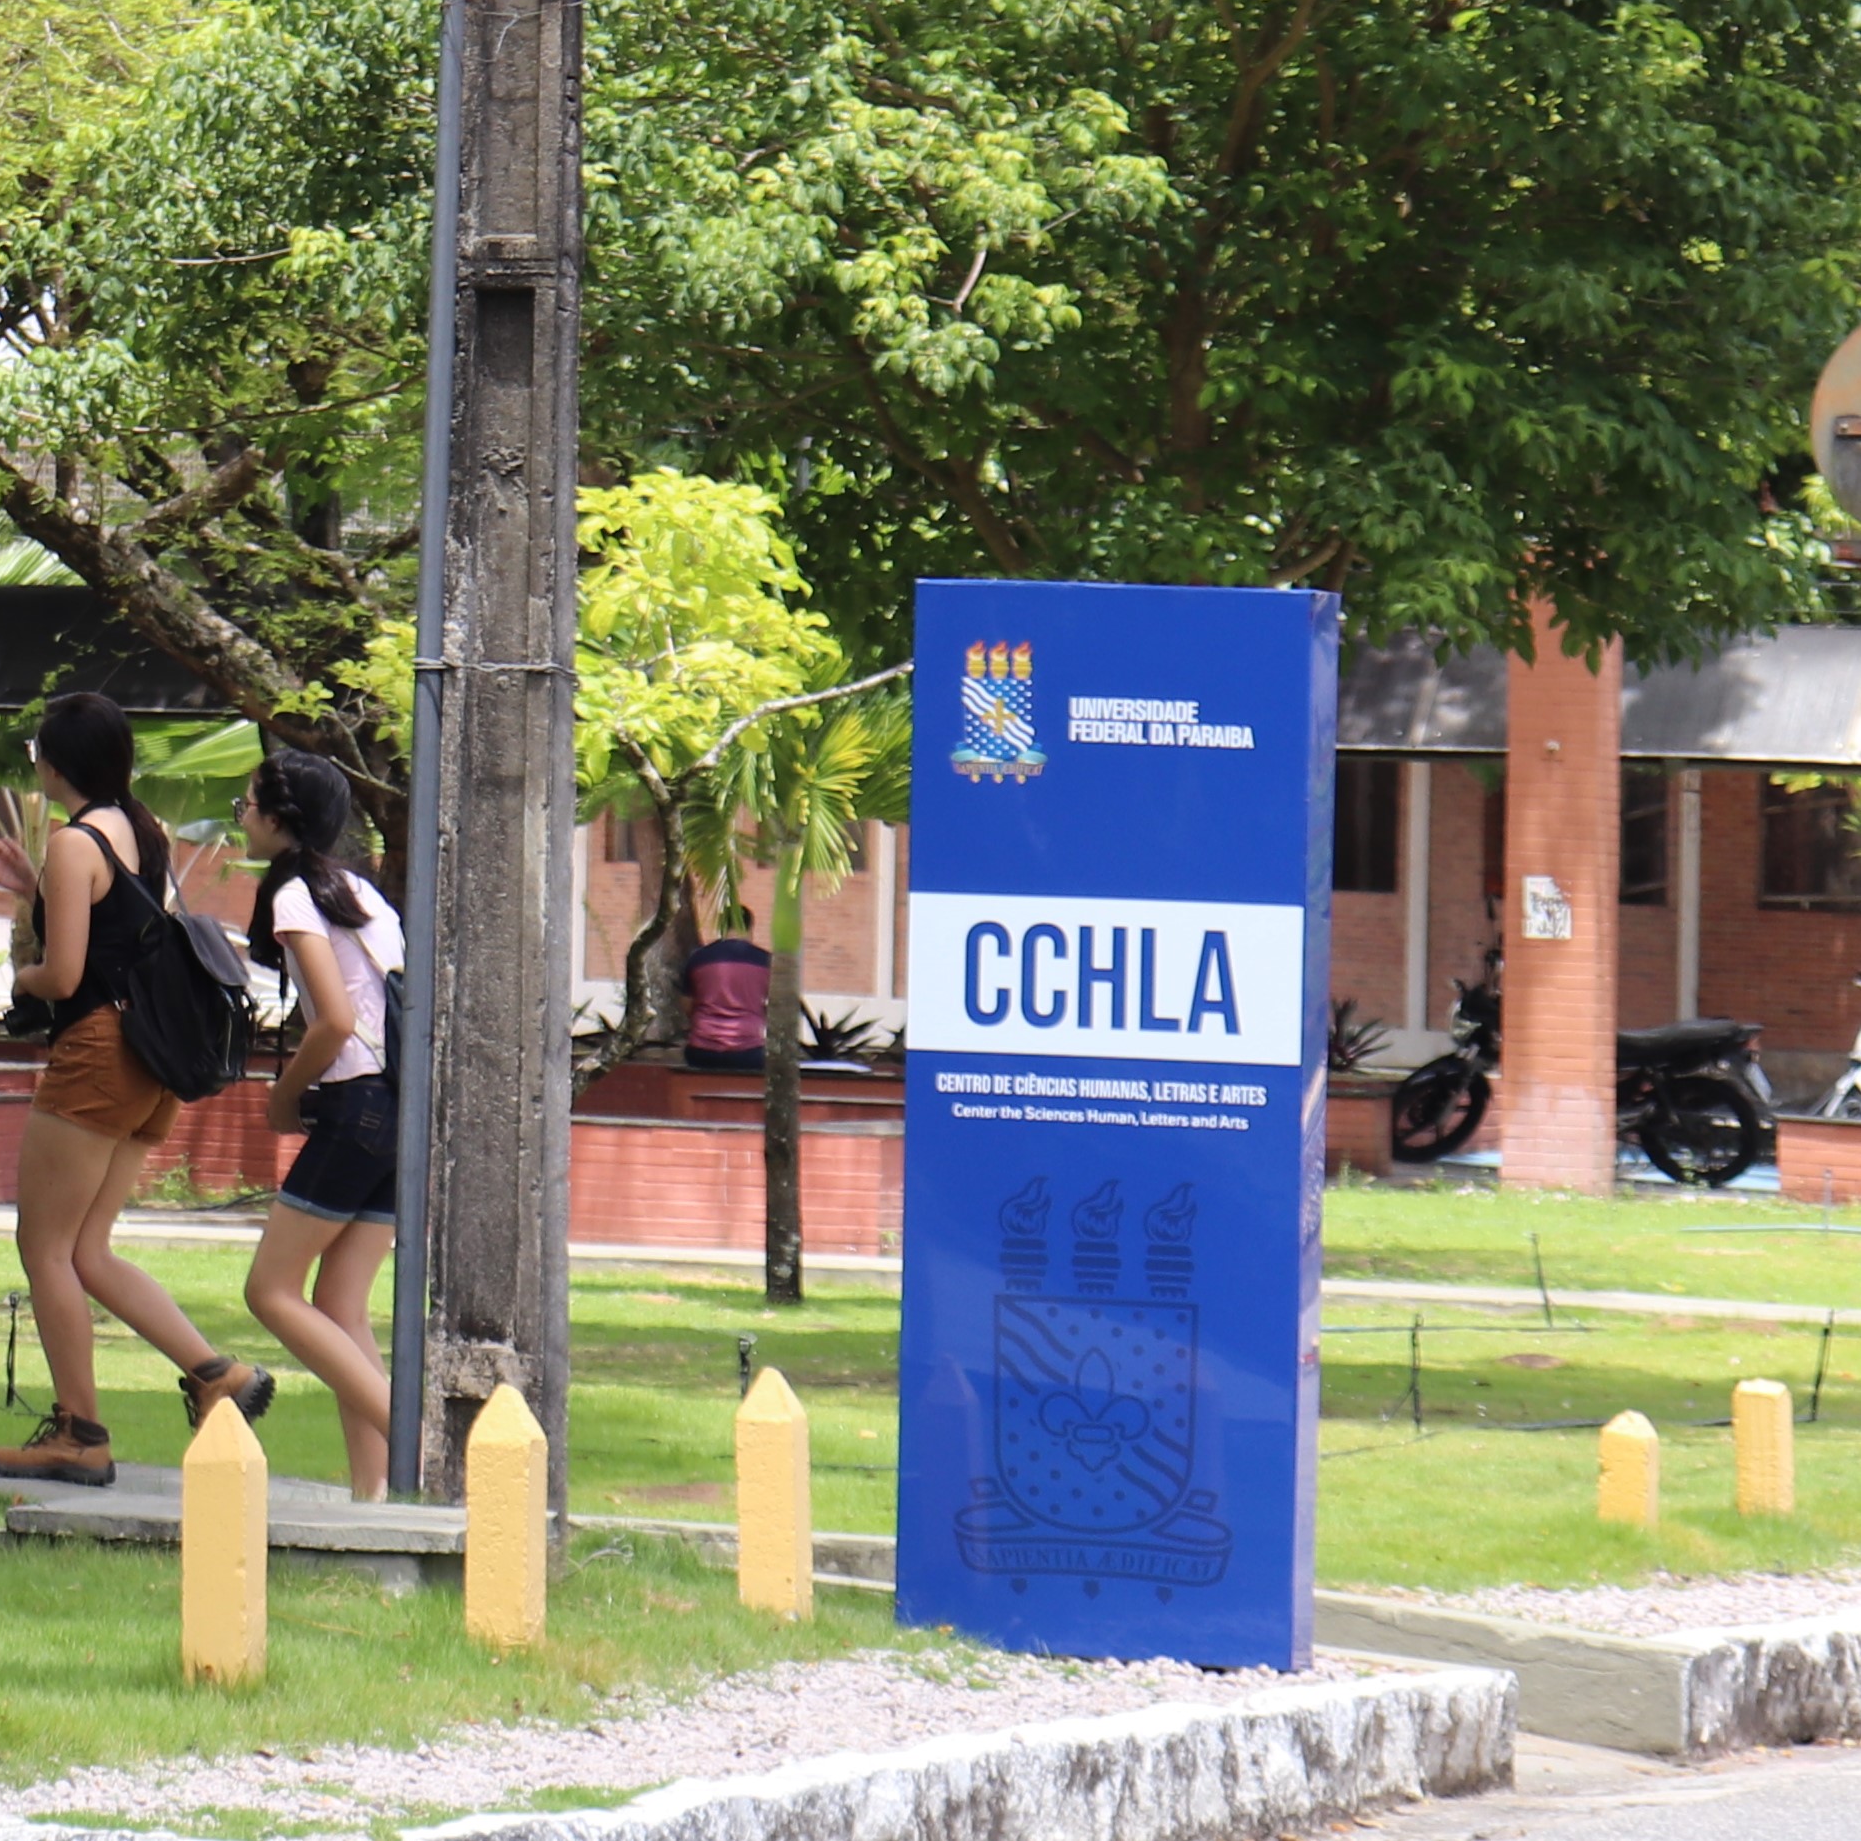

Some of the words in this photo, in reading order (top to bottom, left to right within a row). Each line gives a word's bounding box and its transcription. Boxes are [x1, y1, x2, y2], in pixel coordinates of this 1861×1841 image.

[1069, 696, 1199, 723] UNIVERSIDADE
[1069, 719, 1148, 744] FEDERAL
[1149, 722, 1175, 746] DA
[964, 920, 1242, 1036] CCHLA
[936, 1072, 991, 1094] CENTRO
[993, 1073, 1013, 1095] DE
[1014, 1071, 1077, 1098] CIÊNCIAS
[1078, 1077, 1152, 1102] HUMANAS,
[1153, 1081, 1207, 1103] LETRAS
[1208, 1083, 1220, 1104] E
[1220, 1084, 1268, 1107] ARTES
[951, 1102, 998, 1119] Center
[999, 1104, 1023, 1120] the
[1024, 1105, 1085, 1123] Sciences
[1086, 1108, 1139, 1127] Human,
[1140, 1110, 1189, 1128] Letters
[1191, 1114, 1217, 1129] and
[1219, 1114, 1249, 1131] Arts
